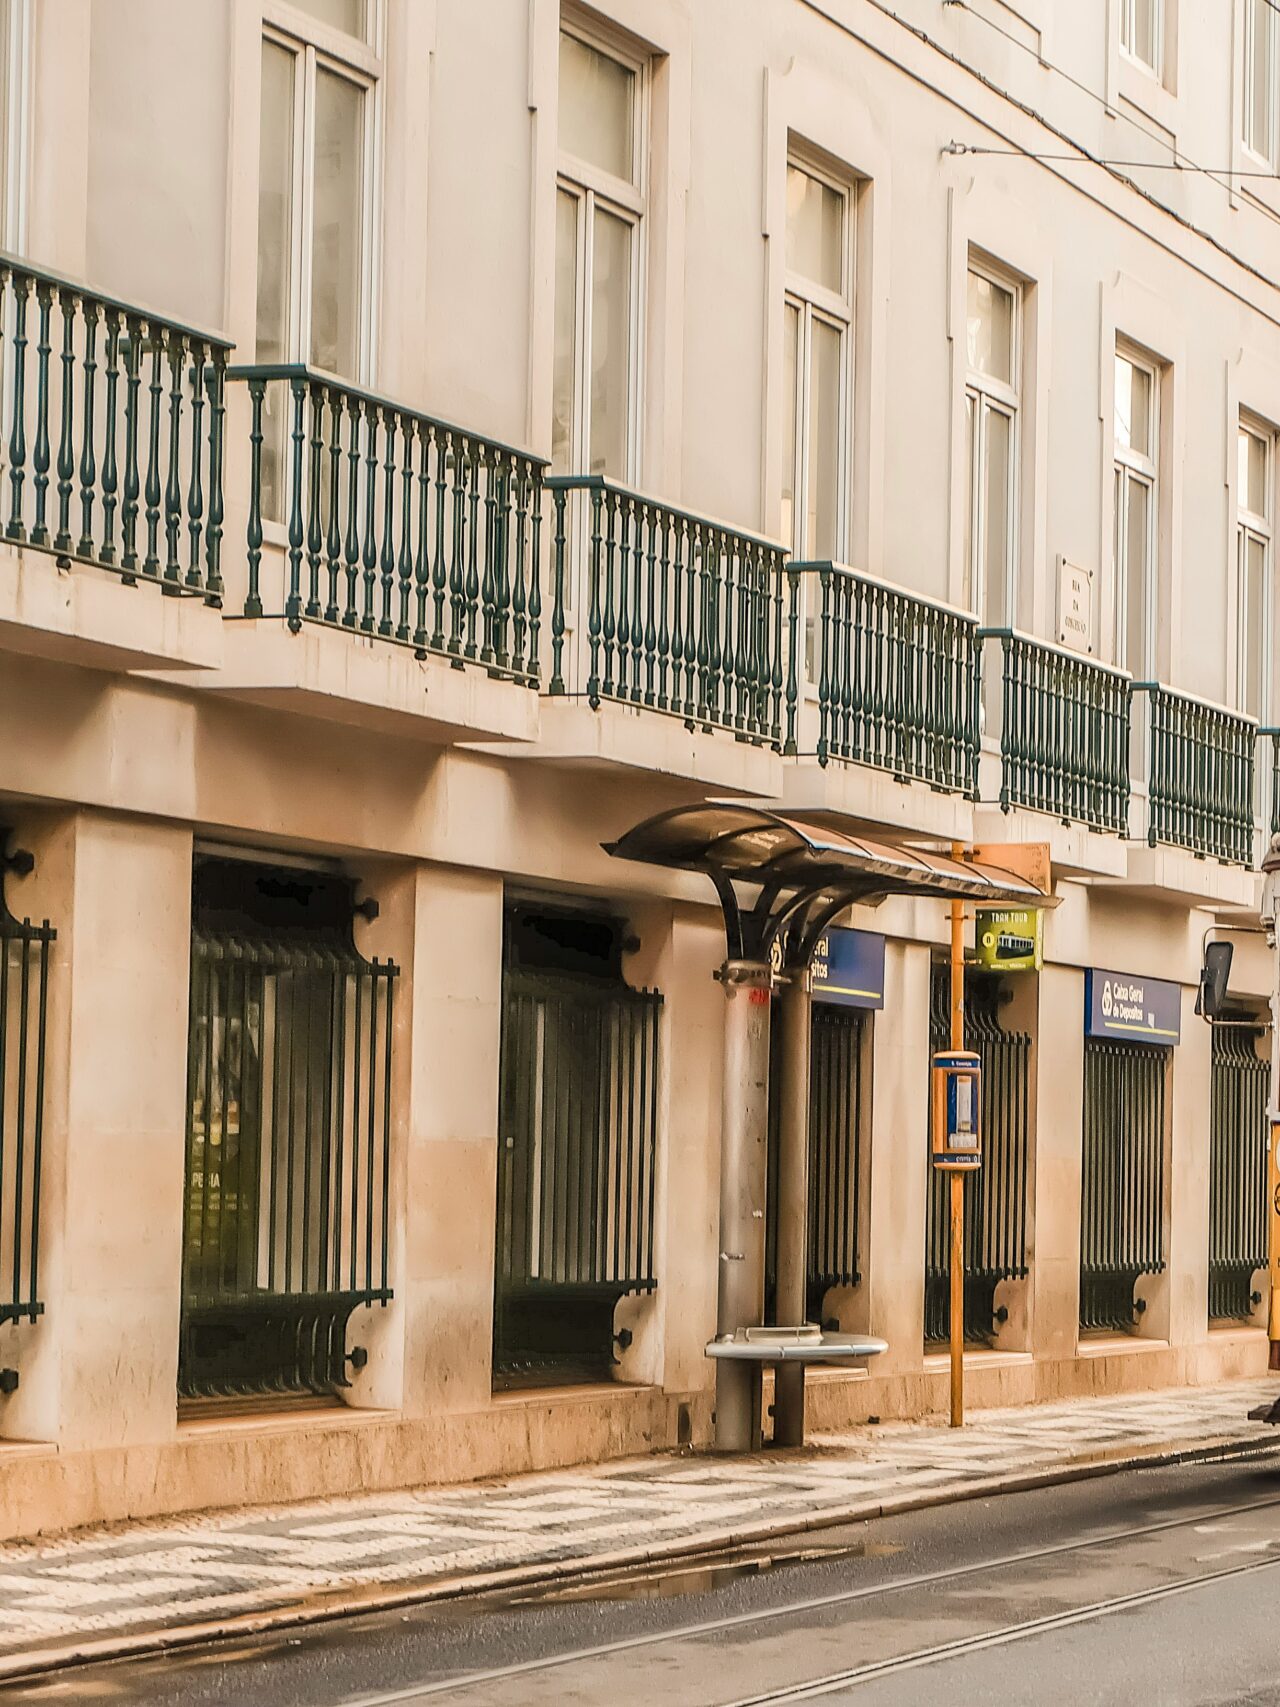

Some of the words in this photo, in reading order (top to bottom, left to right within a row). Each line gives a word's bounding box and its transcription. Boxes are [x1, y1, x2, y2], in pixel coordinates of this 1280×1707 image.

[1010, 912, 1028, 923] TOUR
[1113, 982, 1129, 1001] Caixa
[1129, 984, 1144, 1003] Geral
[1113, 1003, 1119, 1018] de
